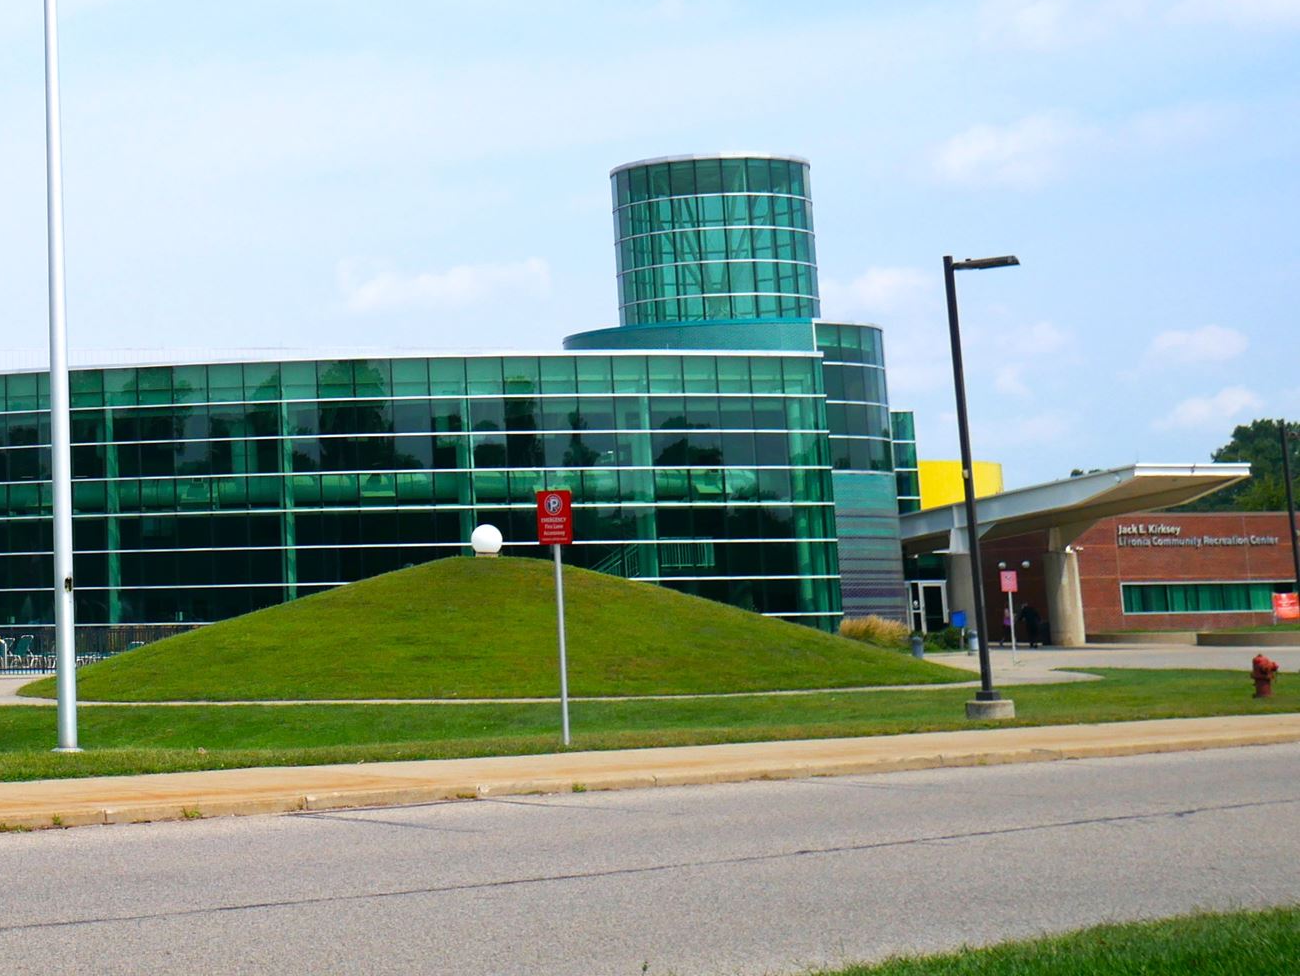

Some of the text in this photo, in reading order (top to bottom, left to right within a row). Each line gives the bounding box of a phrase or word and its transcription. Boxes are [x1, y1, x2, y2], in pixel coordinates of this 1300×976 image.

[1118, 523, 1138, 535] Jack
[1148, 523, 1181, 535] Kirksey
[1152, 536, 1202, 547] Community
[1203, 535, 1250, 545] Recreation
[1250, 535, 1279, 545] Center
